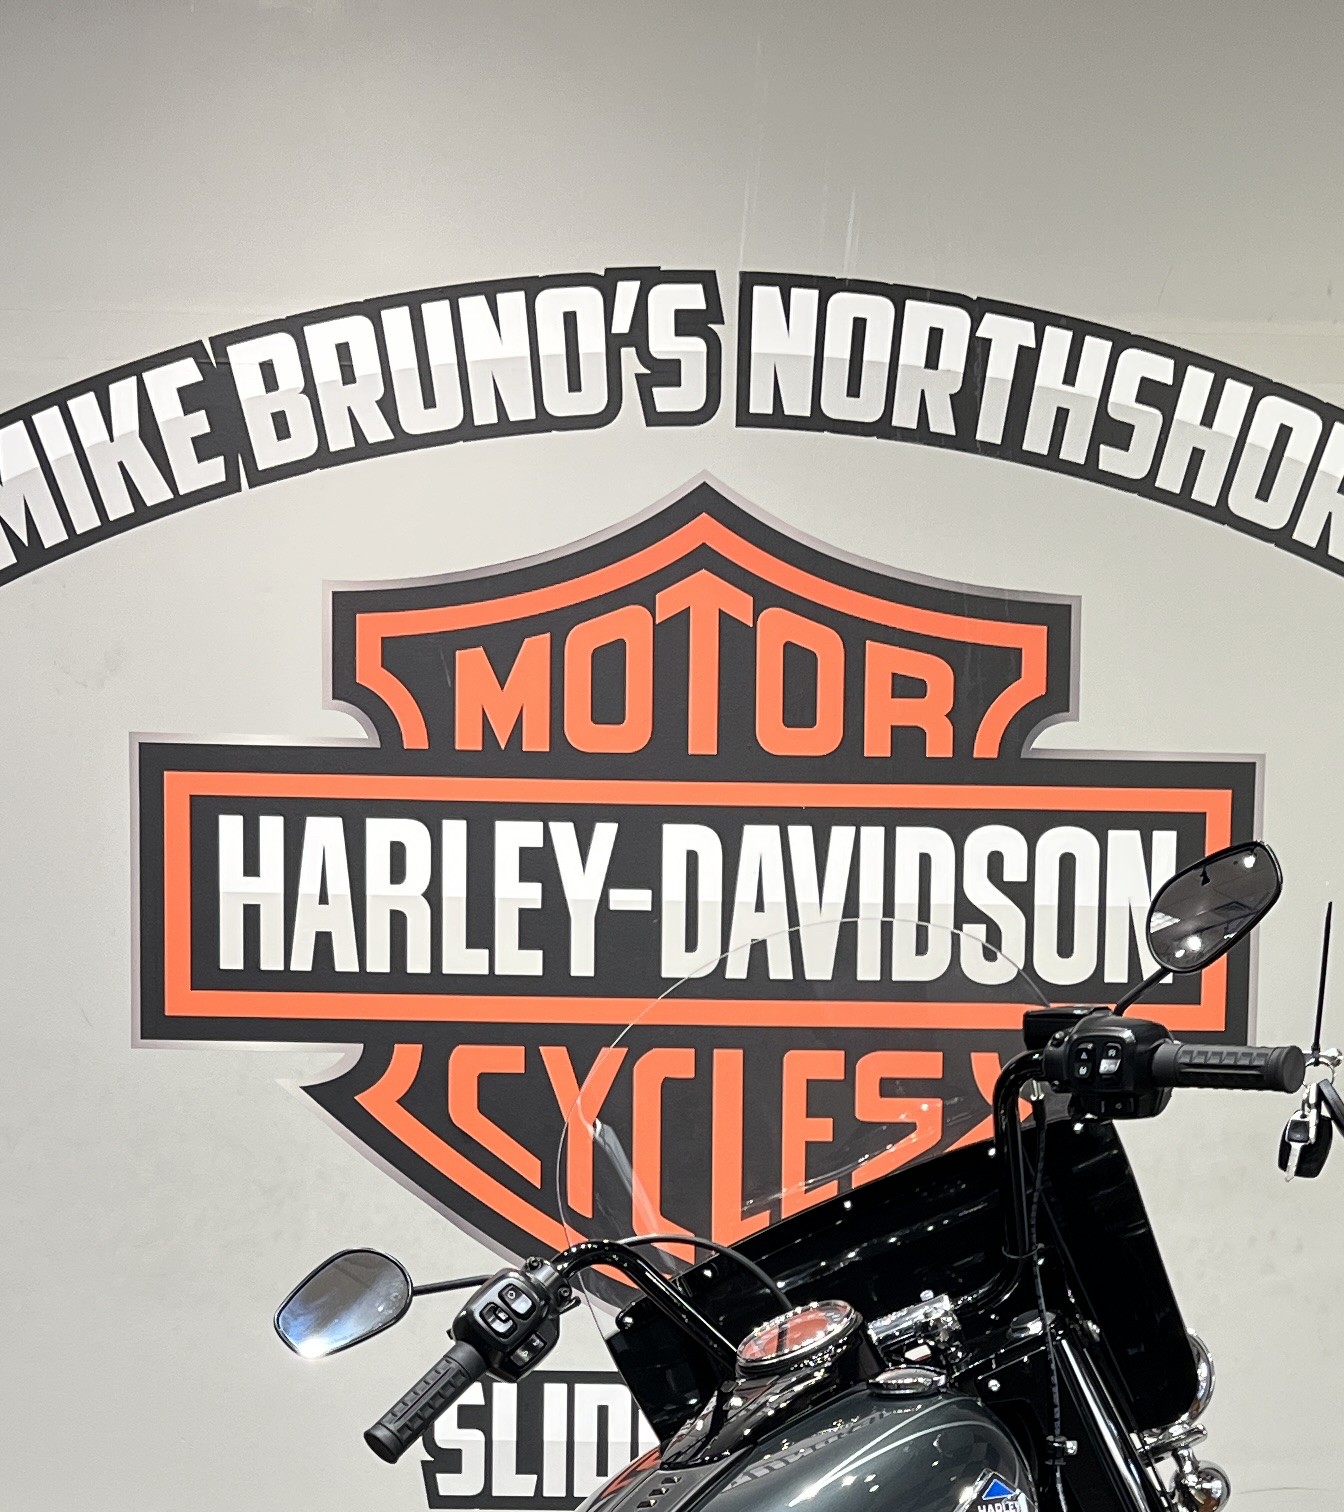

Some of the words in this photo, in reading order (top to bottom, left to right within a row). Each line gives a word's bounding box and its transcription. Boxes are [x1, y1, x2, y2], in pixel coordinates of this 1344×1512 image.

[226, 280, 712, 471] BRUNO'S
[455, 569, 956, 759] MOTOR
[217, 813, 1177, 986] HARLEY-DAVIDSON
[448, 1045, 944, 1265] CYCLES
